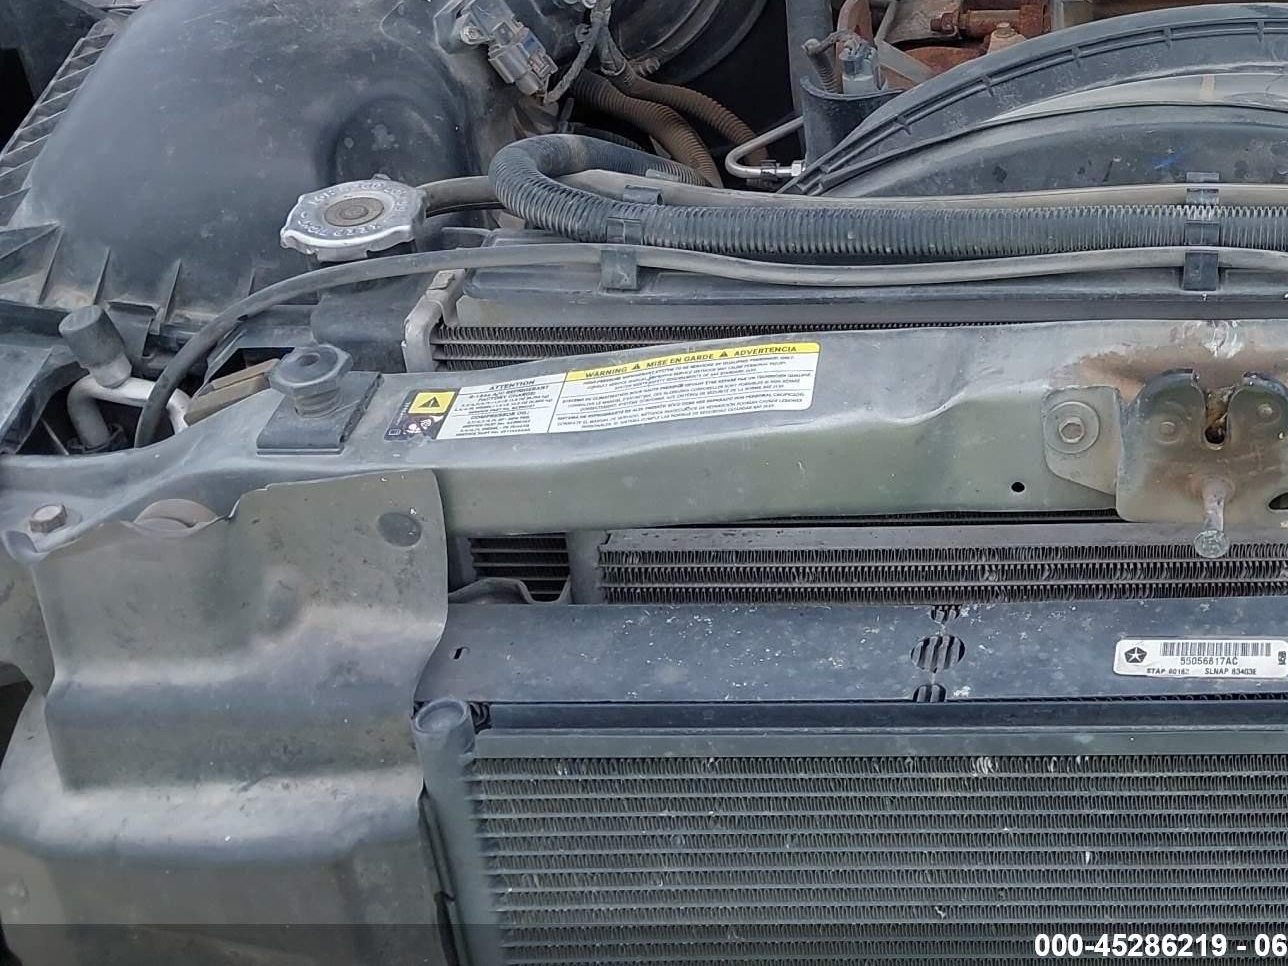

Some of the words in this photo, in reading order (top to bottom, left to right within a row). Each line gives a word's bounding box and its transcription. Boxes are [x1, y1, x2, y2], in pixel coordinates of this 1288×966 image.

[584, 366, 629, 380] WARNING
[646, 358, 668, 369] MISE
[669, 356, 682, 365] EN
[682, 353, 715, 364] GARDE
[733, 346, 797, 357] ADVERTENCIA
